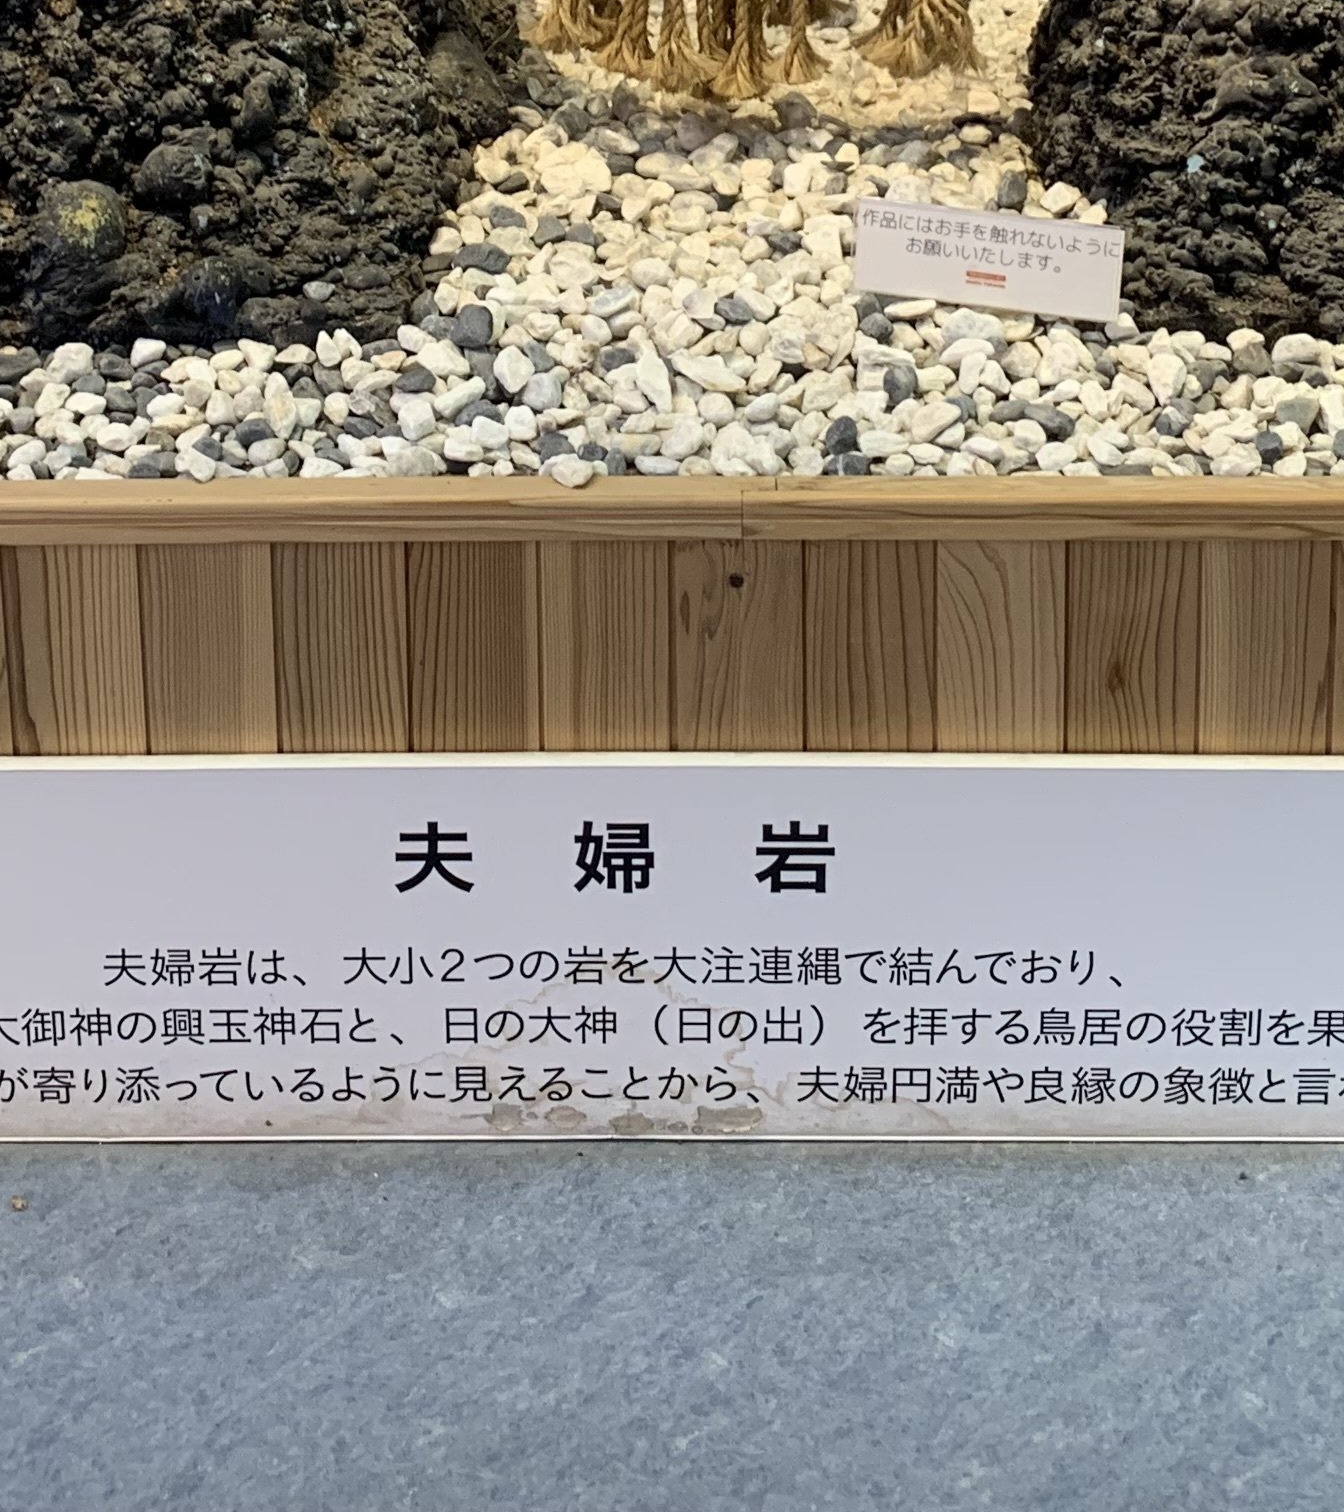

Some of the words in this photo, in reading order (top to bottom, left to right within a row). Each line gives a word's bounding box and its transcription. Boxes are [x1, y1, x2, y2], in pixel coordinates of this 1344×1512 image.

[862, 208, 1121, 259] 作品にはお手を触れないように
[905, 237, 1062, 274] お願いいたします。
